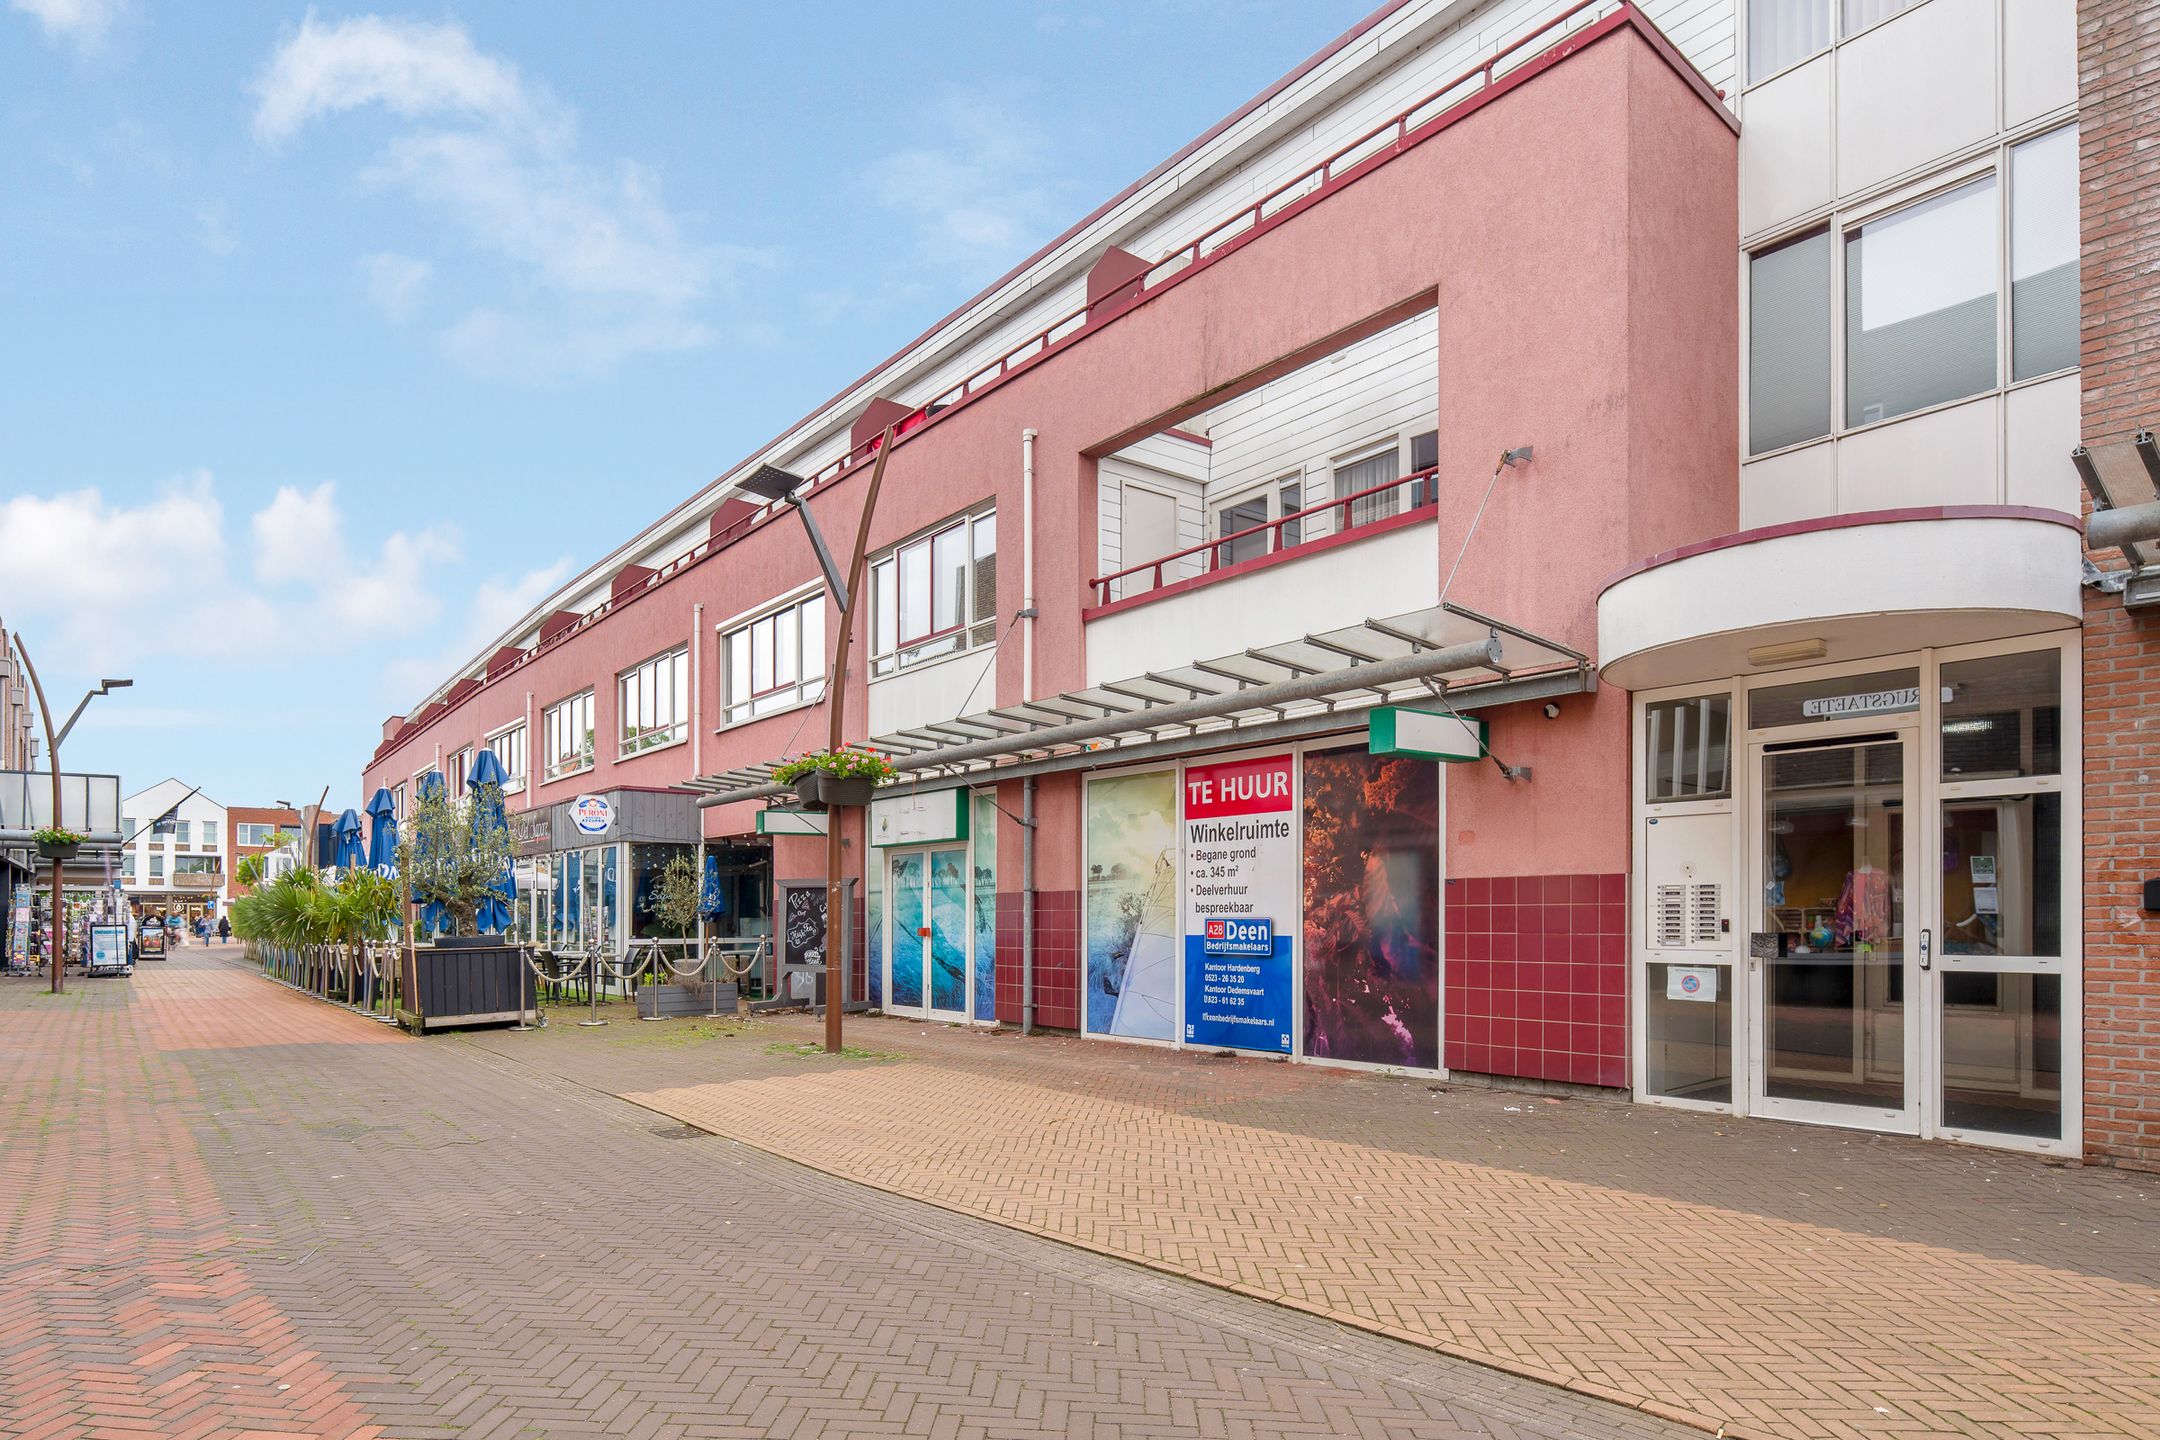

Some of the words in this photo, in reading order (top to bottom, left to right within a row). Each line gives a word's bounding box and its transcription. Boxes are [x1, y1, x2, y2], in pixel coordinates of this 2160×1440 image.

[1188, 780, 1213, 805] TE
[1221, 771, 1289, 802] HUUR
[578, 808, 608, 817] PERONI
[1190, 819, 1290, 843] Winkelruimte
[1196, 849, 1228, 863] Begane
[1230, 846, 1256, 862] grond
[1196, 869, 1208, 878] ca.
[1210, 866, 1225, 878] 345
[1196, 884, 1248, 896] Deelverhuur
[1195, 901, 1254, 915] bespreekbaar
[1208, 924, 1223, 935] A28
[1226, 921, 1268, 940] Deen
[1206, 941, 1269, 953] Bedrijfsmakelaars
[1204, 963, 1226, 972] Kantoor
[1227, 964, 1260, 975] Hardenberg
[1204, 974, 1218, 982] 0523
[1204, 985, 1226, 994] Kantoor
[1227, 986, 1264, 996] Dedemsvaart
